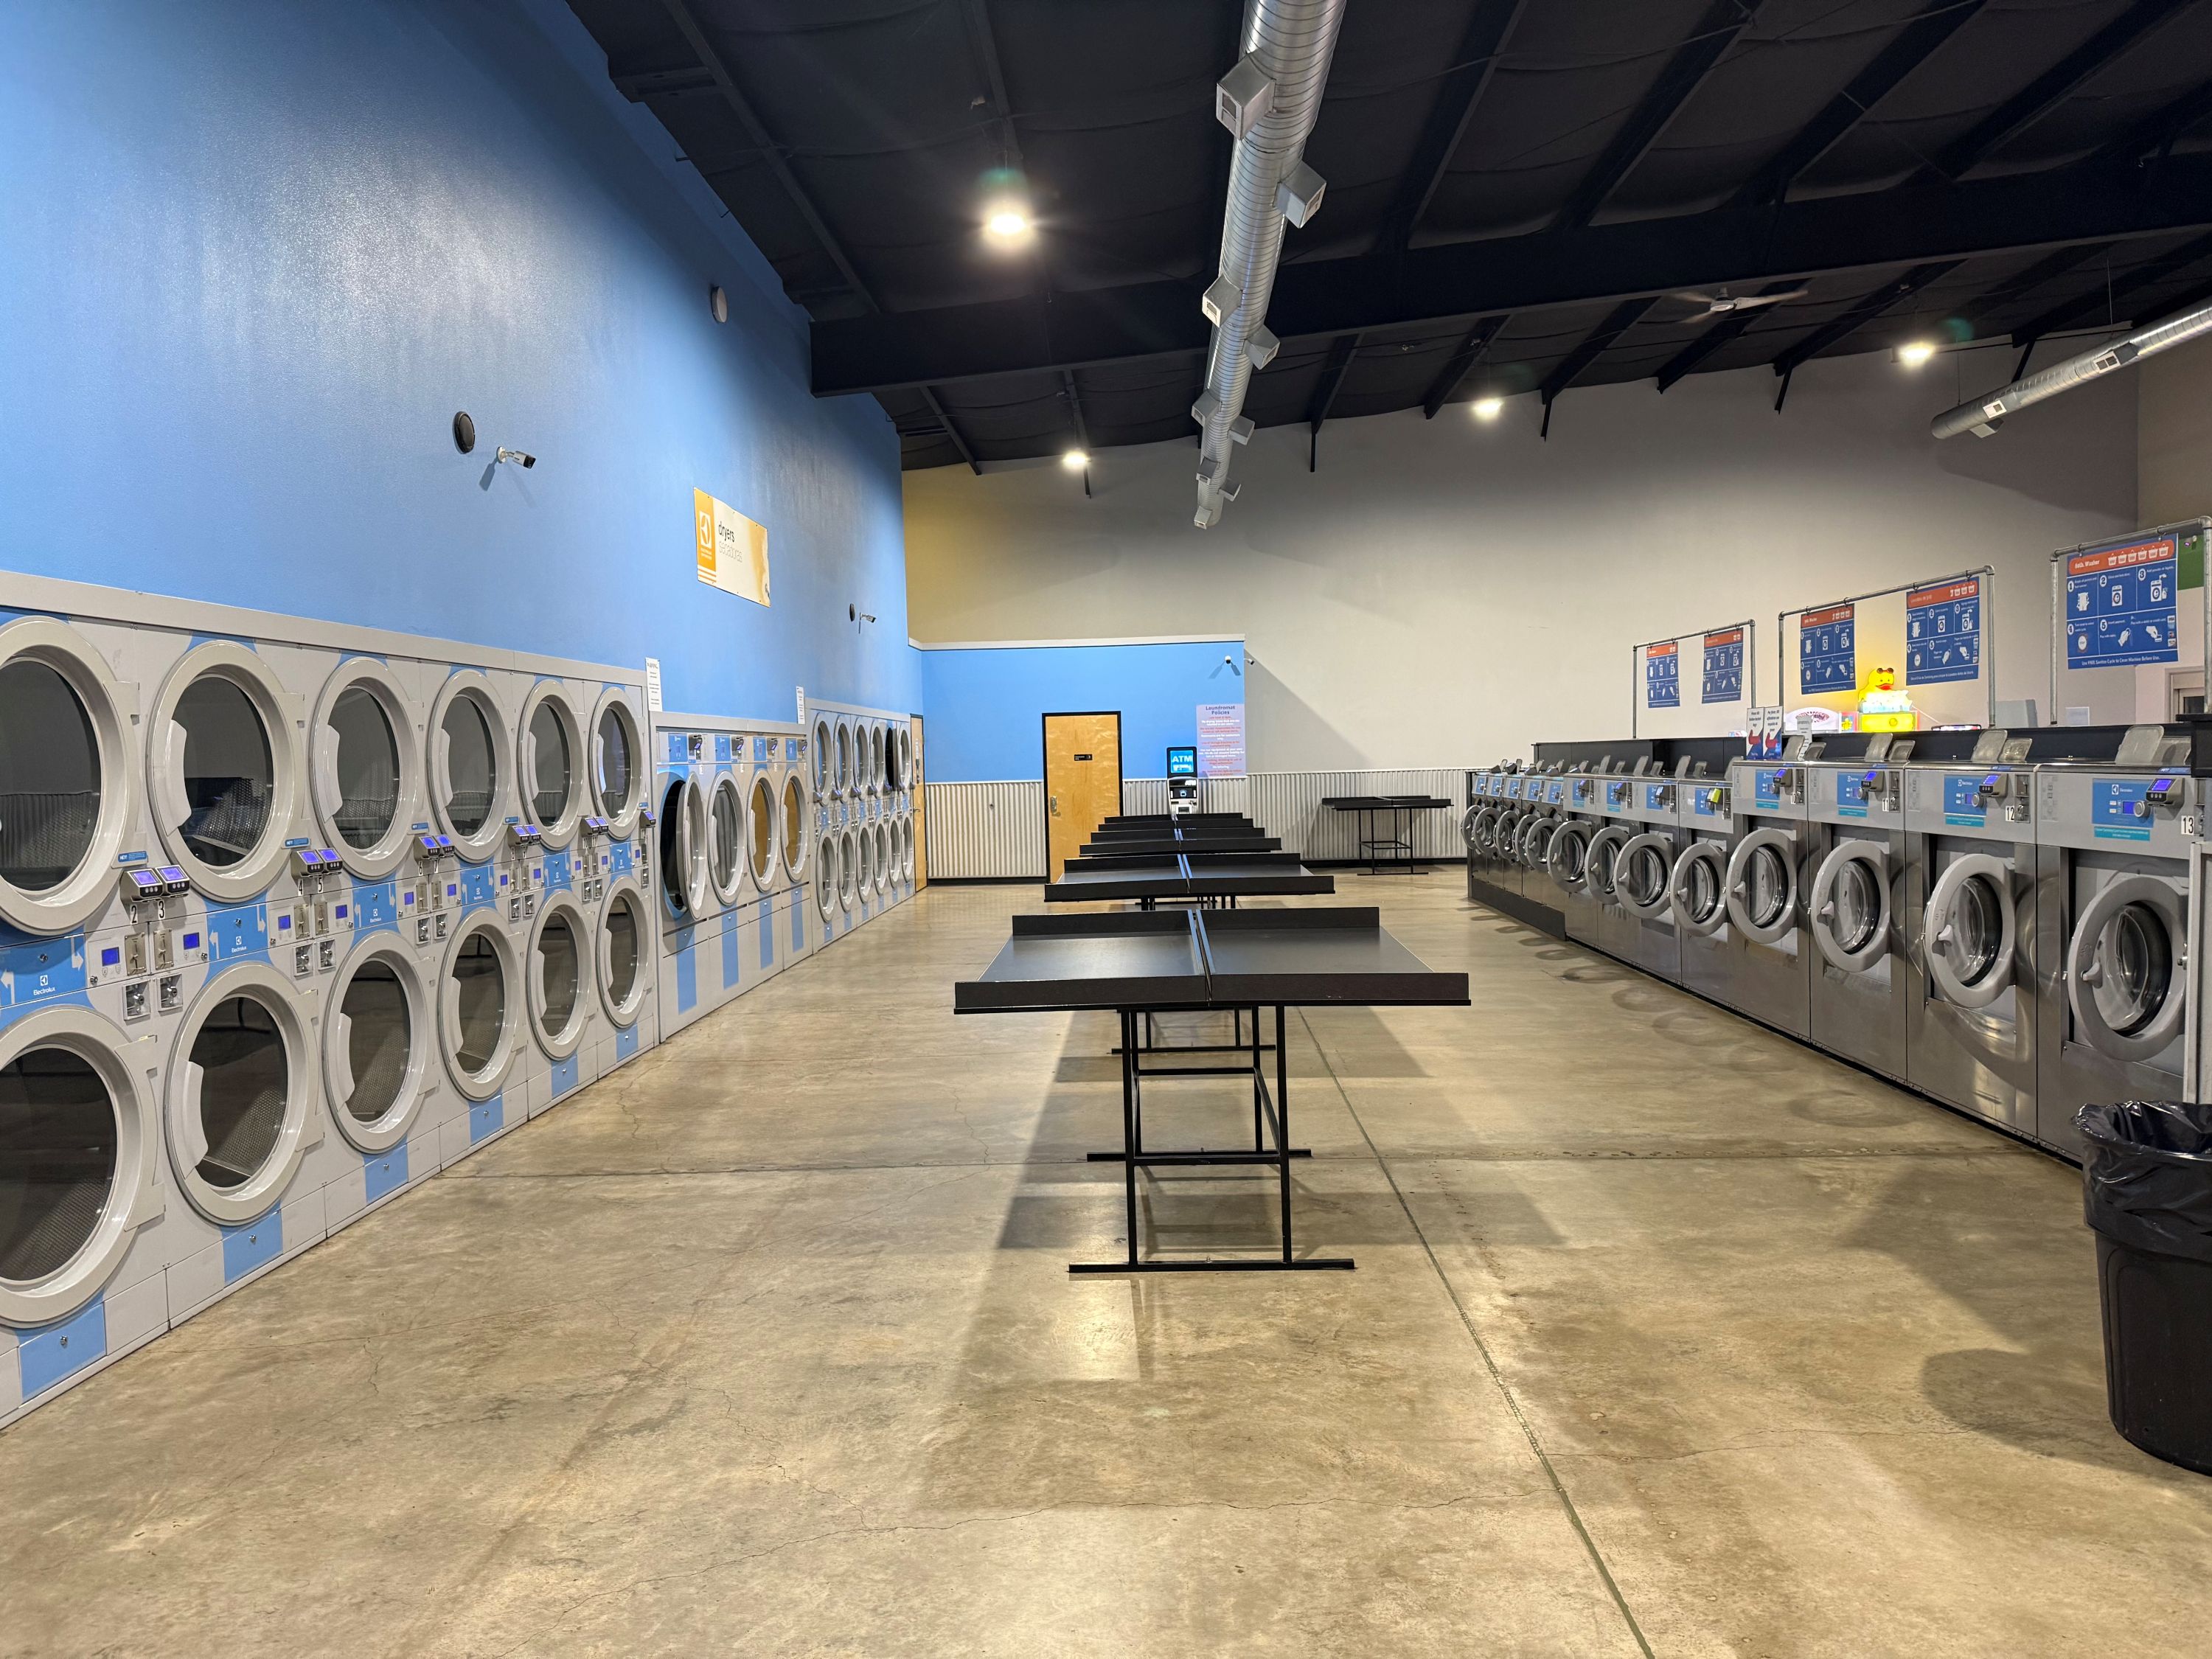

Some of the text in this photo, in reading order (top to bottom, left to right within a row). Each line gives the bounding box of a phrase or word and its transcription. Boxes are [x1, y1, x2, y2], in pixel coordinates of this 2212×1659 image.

[718, 521, 735, 543] dryers
[2006, 807, 2014, 821] 12
[2183, 817, 2194, 834] 13
[299, 879, 303, 895] 4
[318, 877, 323, 892] 5
[131, 905, 137, 924] 2
[159, 900, 164, 919] 3
[33, 987, 56, 995] Electrolux
